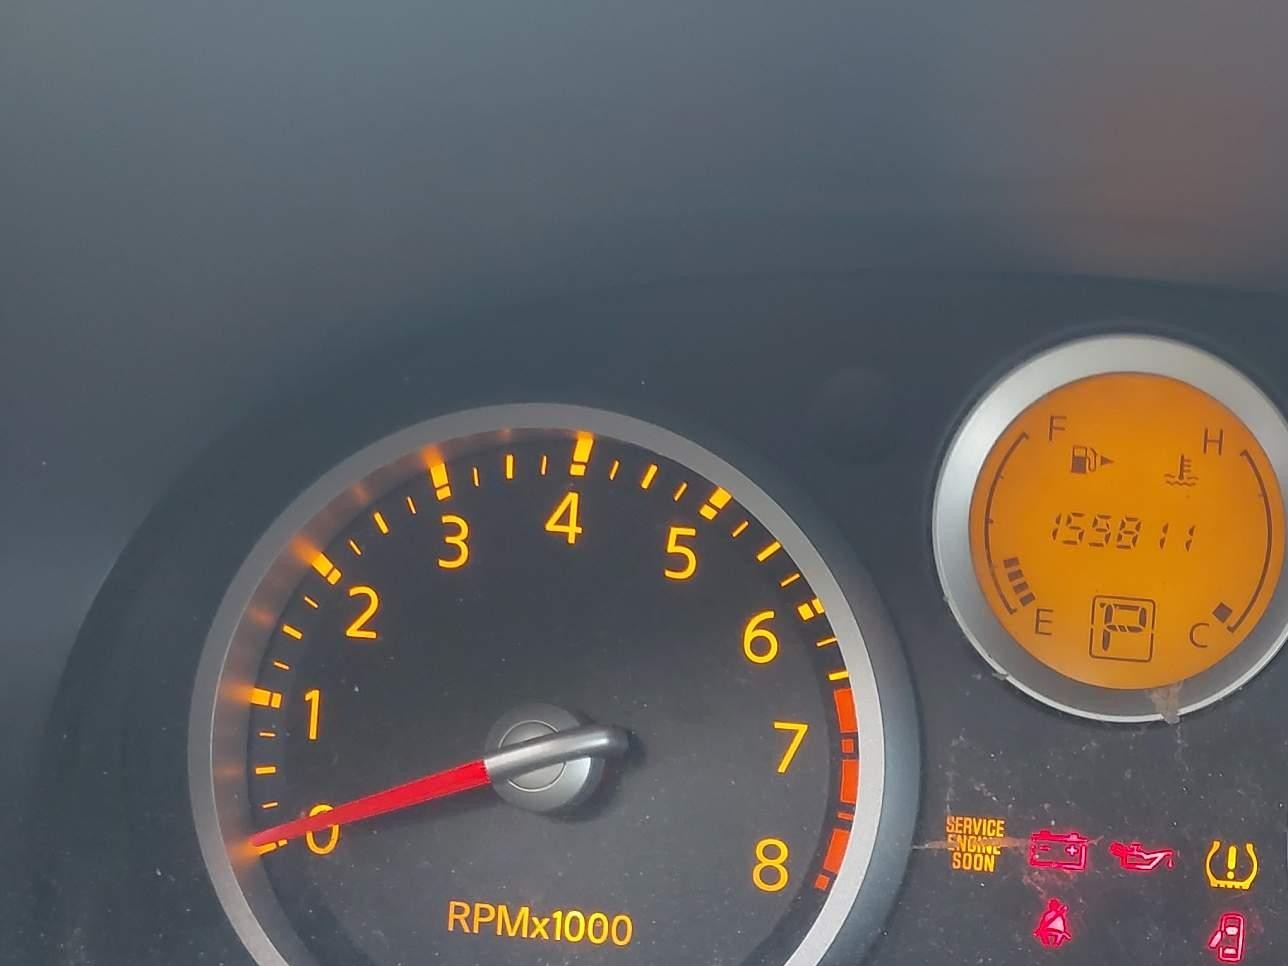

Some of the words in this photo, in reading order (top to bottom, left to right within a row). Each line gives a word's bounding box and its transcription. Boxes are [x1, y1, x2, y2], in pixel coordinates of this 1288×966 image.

[1048, 414, 1067, 442] F
[1202, 427, 1224, 456] H
[438, 514, 469, 569] 3
[544, 491, 583, 545] 4
[664, 526, 697, 581] 5
[345, 585, 379, 639] 2
[743, 610, 779, 664] 6
[1034, 608, 1054, 636] E
[1099, 601, 1147, 652] P
[1188, 621, 1210, 649] C
[304, 689, 321, 740] 1
[773, 720, 809, 774] 7
[305, 804, 340, 855] 0
[945, 815, 1006, 838] SERVICE
[752, 838, 789, 892] 8
[952, 851, 996, 873] SOON
[447, 900, 633, 947] RPMx1000
